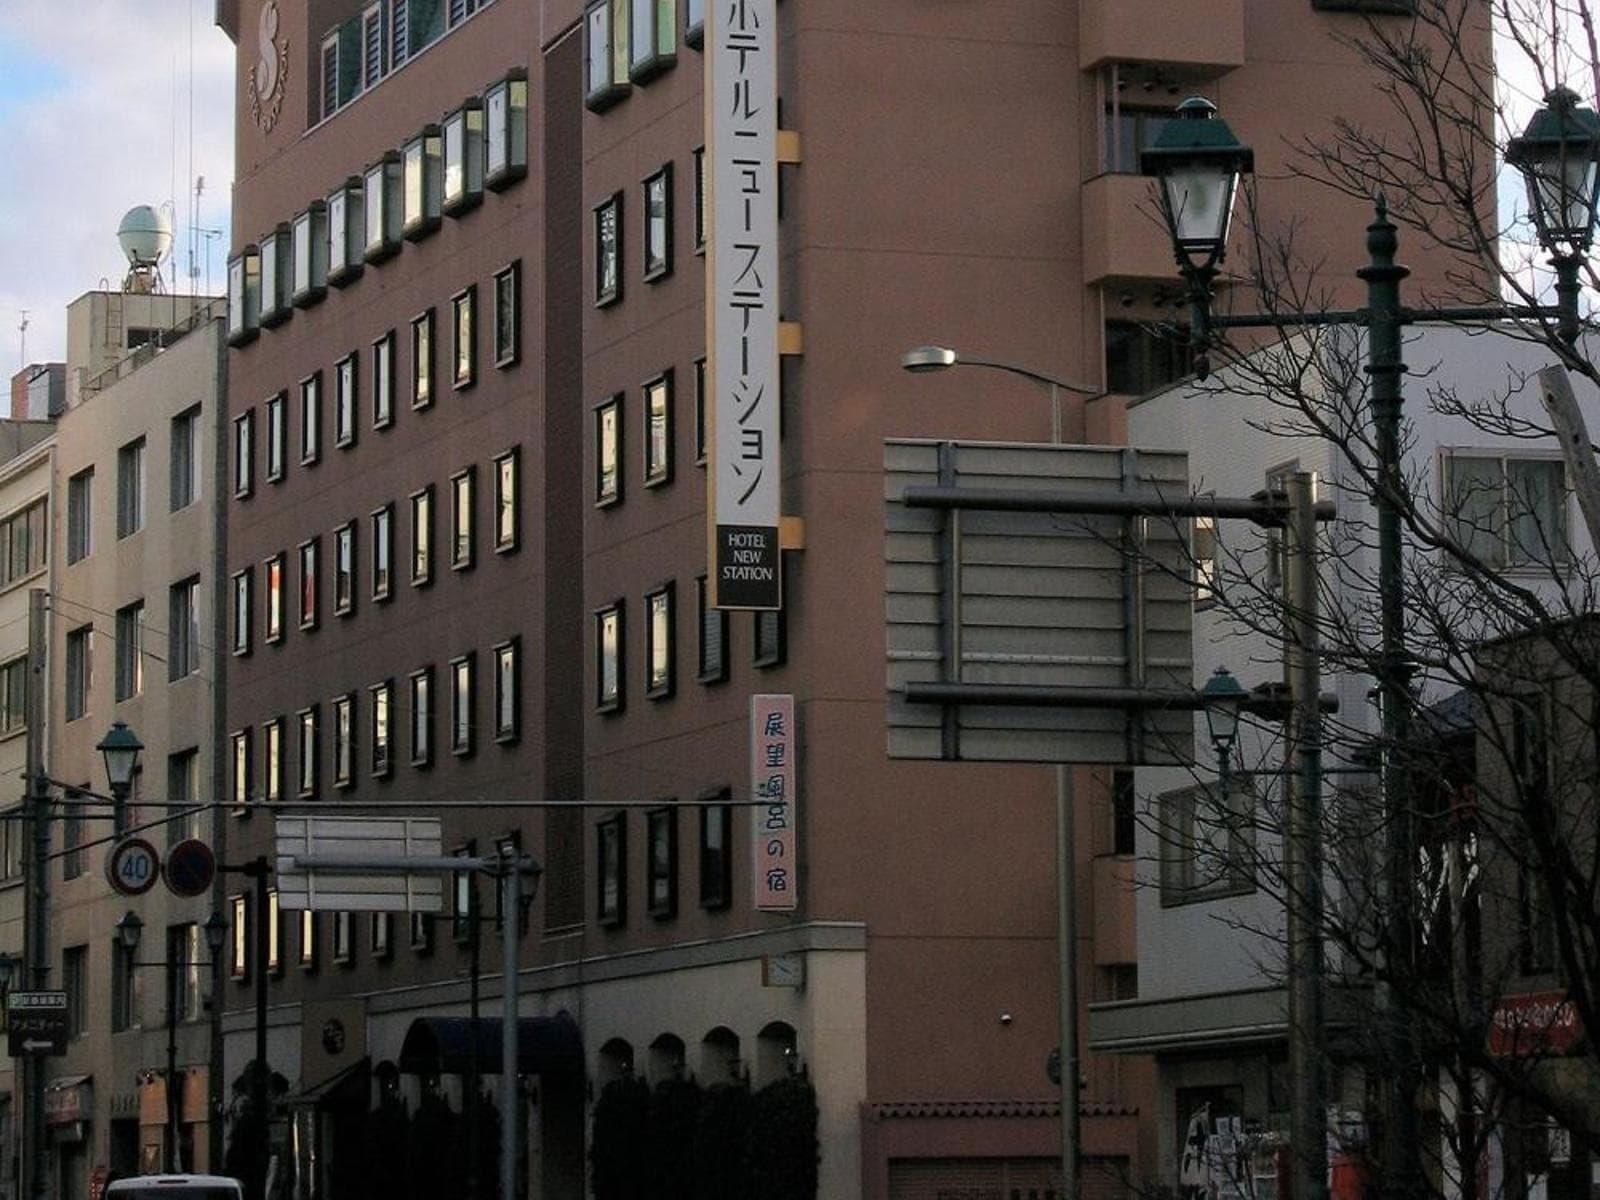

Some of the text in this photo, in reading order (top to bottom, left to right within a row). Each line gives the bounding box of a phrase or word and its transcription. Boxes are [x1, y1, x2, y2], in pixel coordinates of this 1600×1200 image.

[728, 533, 766, 548] HOTEL
[733, 550, 762, 564] NEW
[722, 565, 772, 580] STATION
[122, 854, 149, 879] 40
